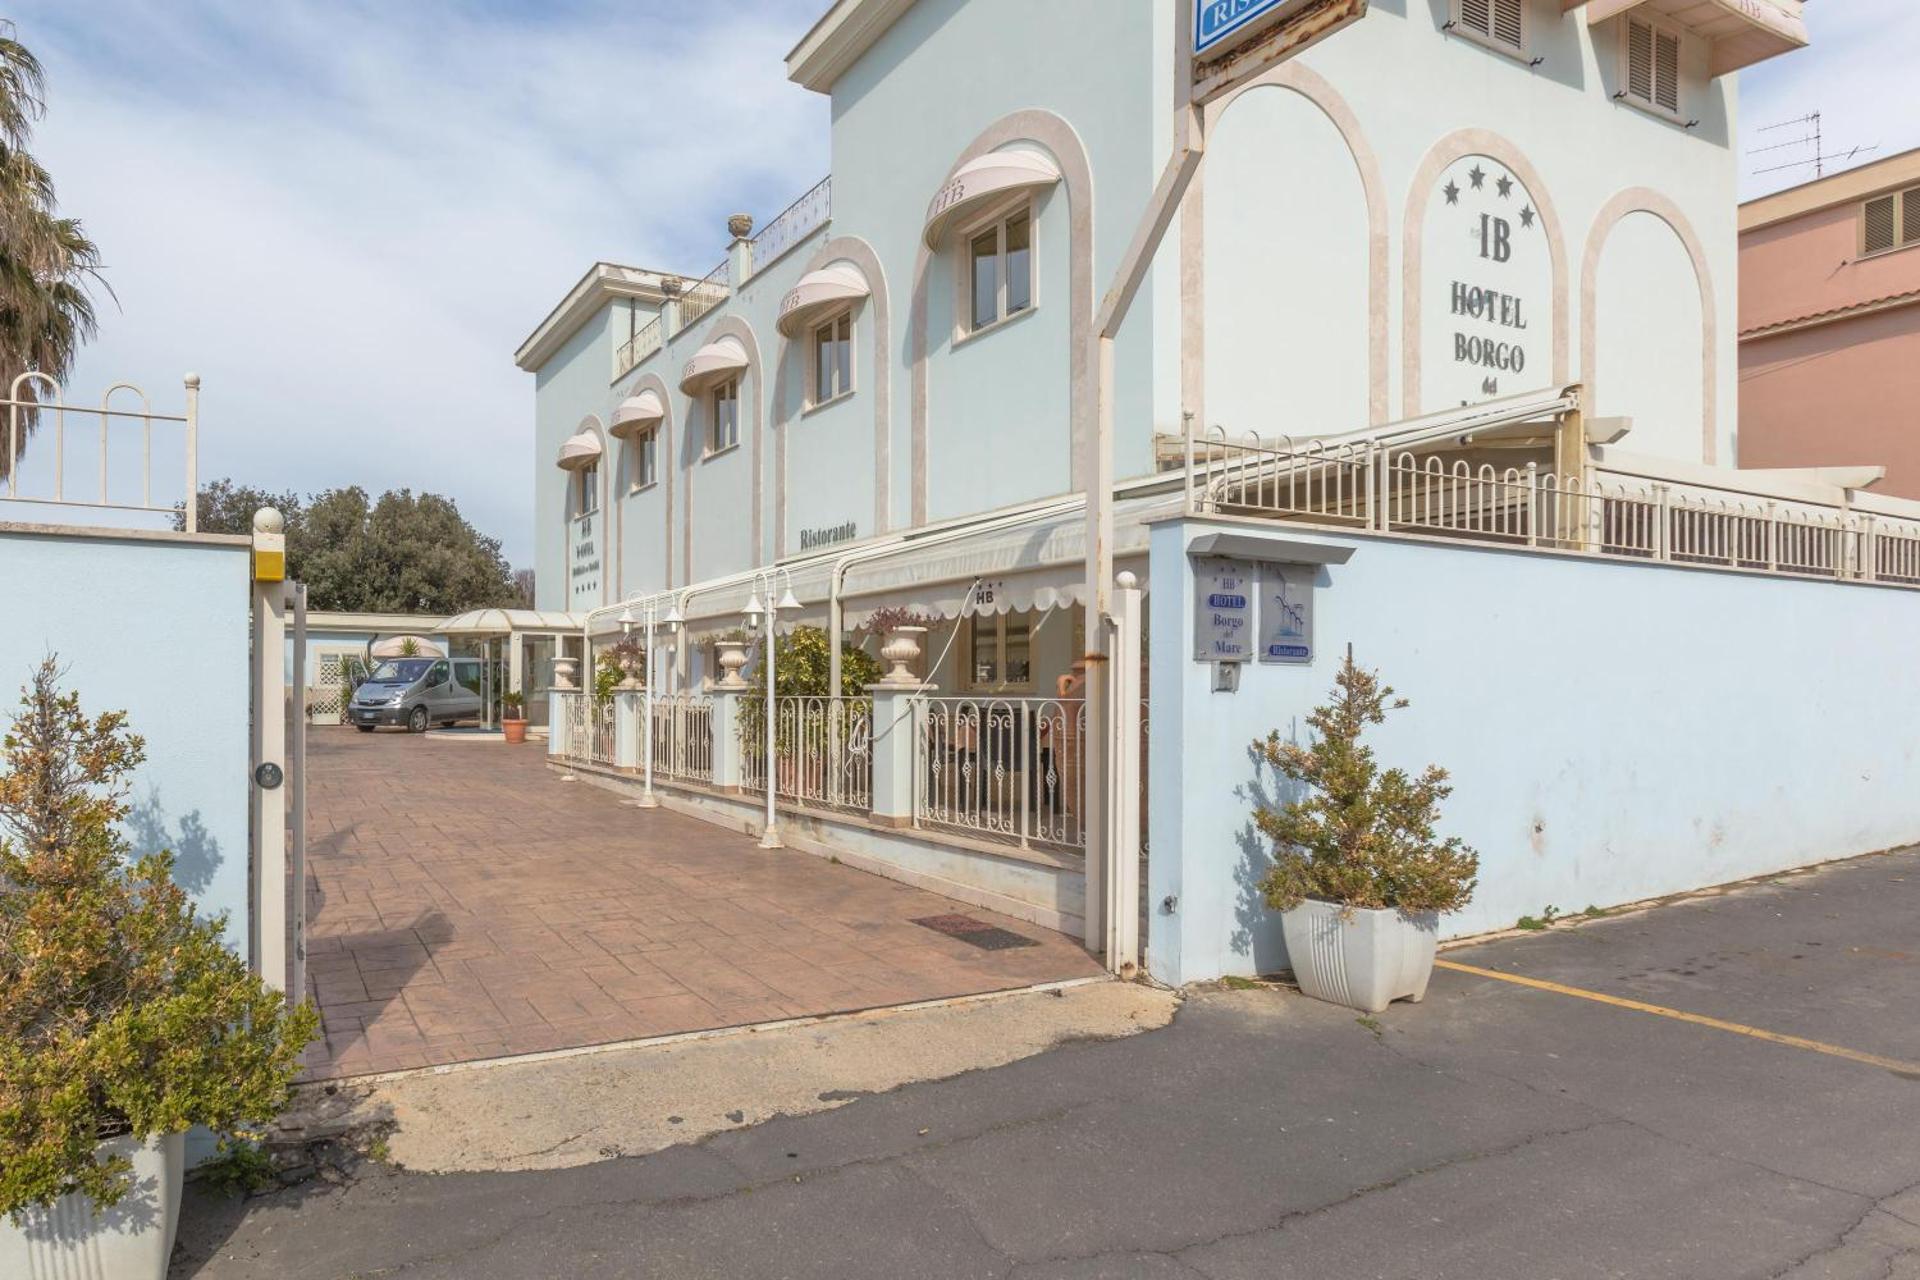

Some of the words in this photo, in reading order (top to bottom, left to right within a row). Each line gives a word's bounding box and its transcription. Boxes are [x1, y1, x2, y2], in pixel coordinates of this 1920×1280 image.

[1450, 280, 1527, 329] HOTEL
[1454, 332, 1525, 374] BORGO
[800, 521, 856, 550] Ristorante
[976, 591, 994, 605] HB
[1213, 595, 1242, 607] HOTEL
[1213, 613, 1244, 629] Borgo
[1215, 641, 1242, 654] Mare
